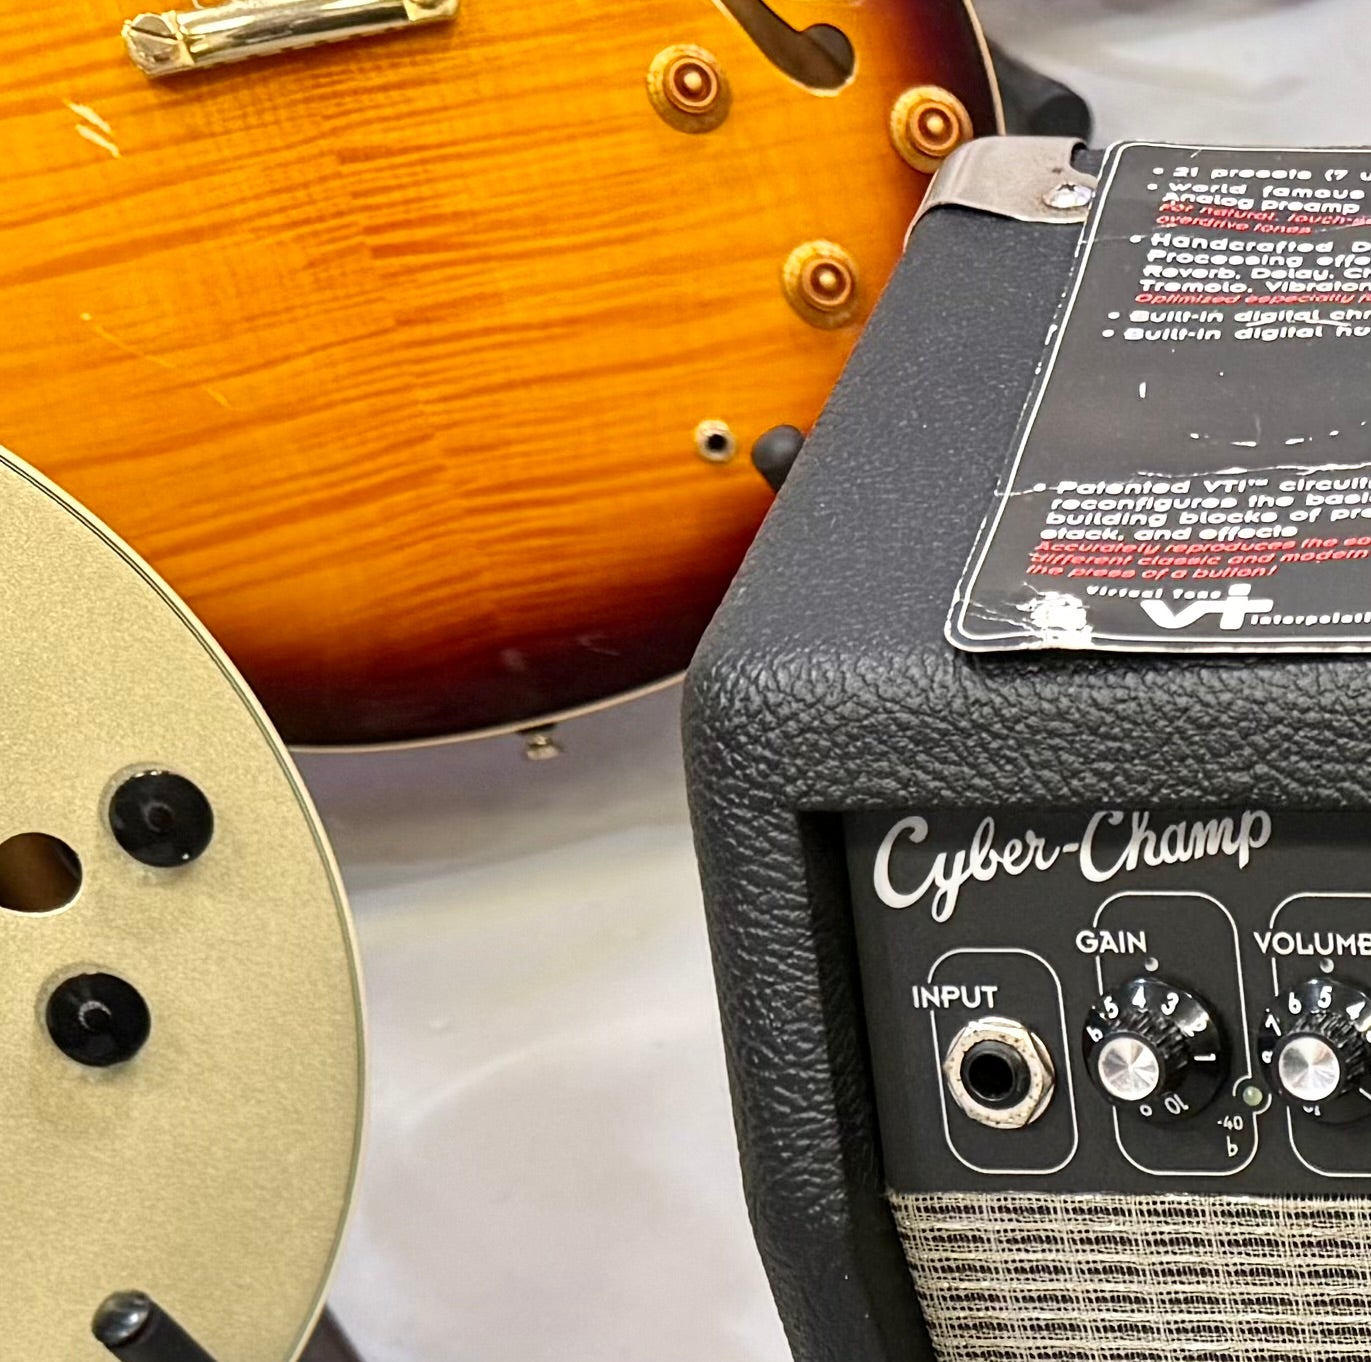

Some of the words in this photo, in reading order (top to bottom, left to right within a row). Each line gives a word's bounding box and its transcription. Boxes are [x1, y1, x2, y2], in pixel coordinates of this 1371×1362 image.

[1289, 507, 1322, 522] of
[1134, 527, 1192, 541] and
[873, 809, 1272, 923] Cyber-Champ
[1076, 930, 1147, 954] GAIN
[911, 985, 998, 1009] INPUT
